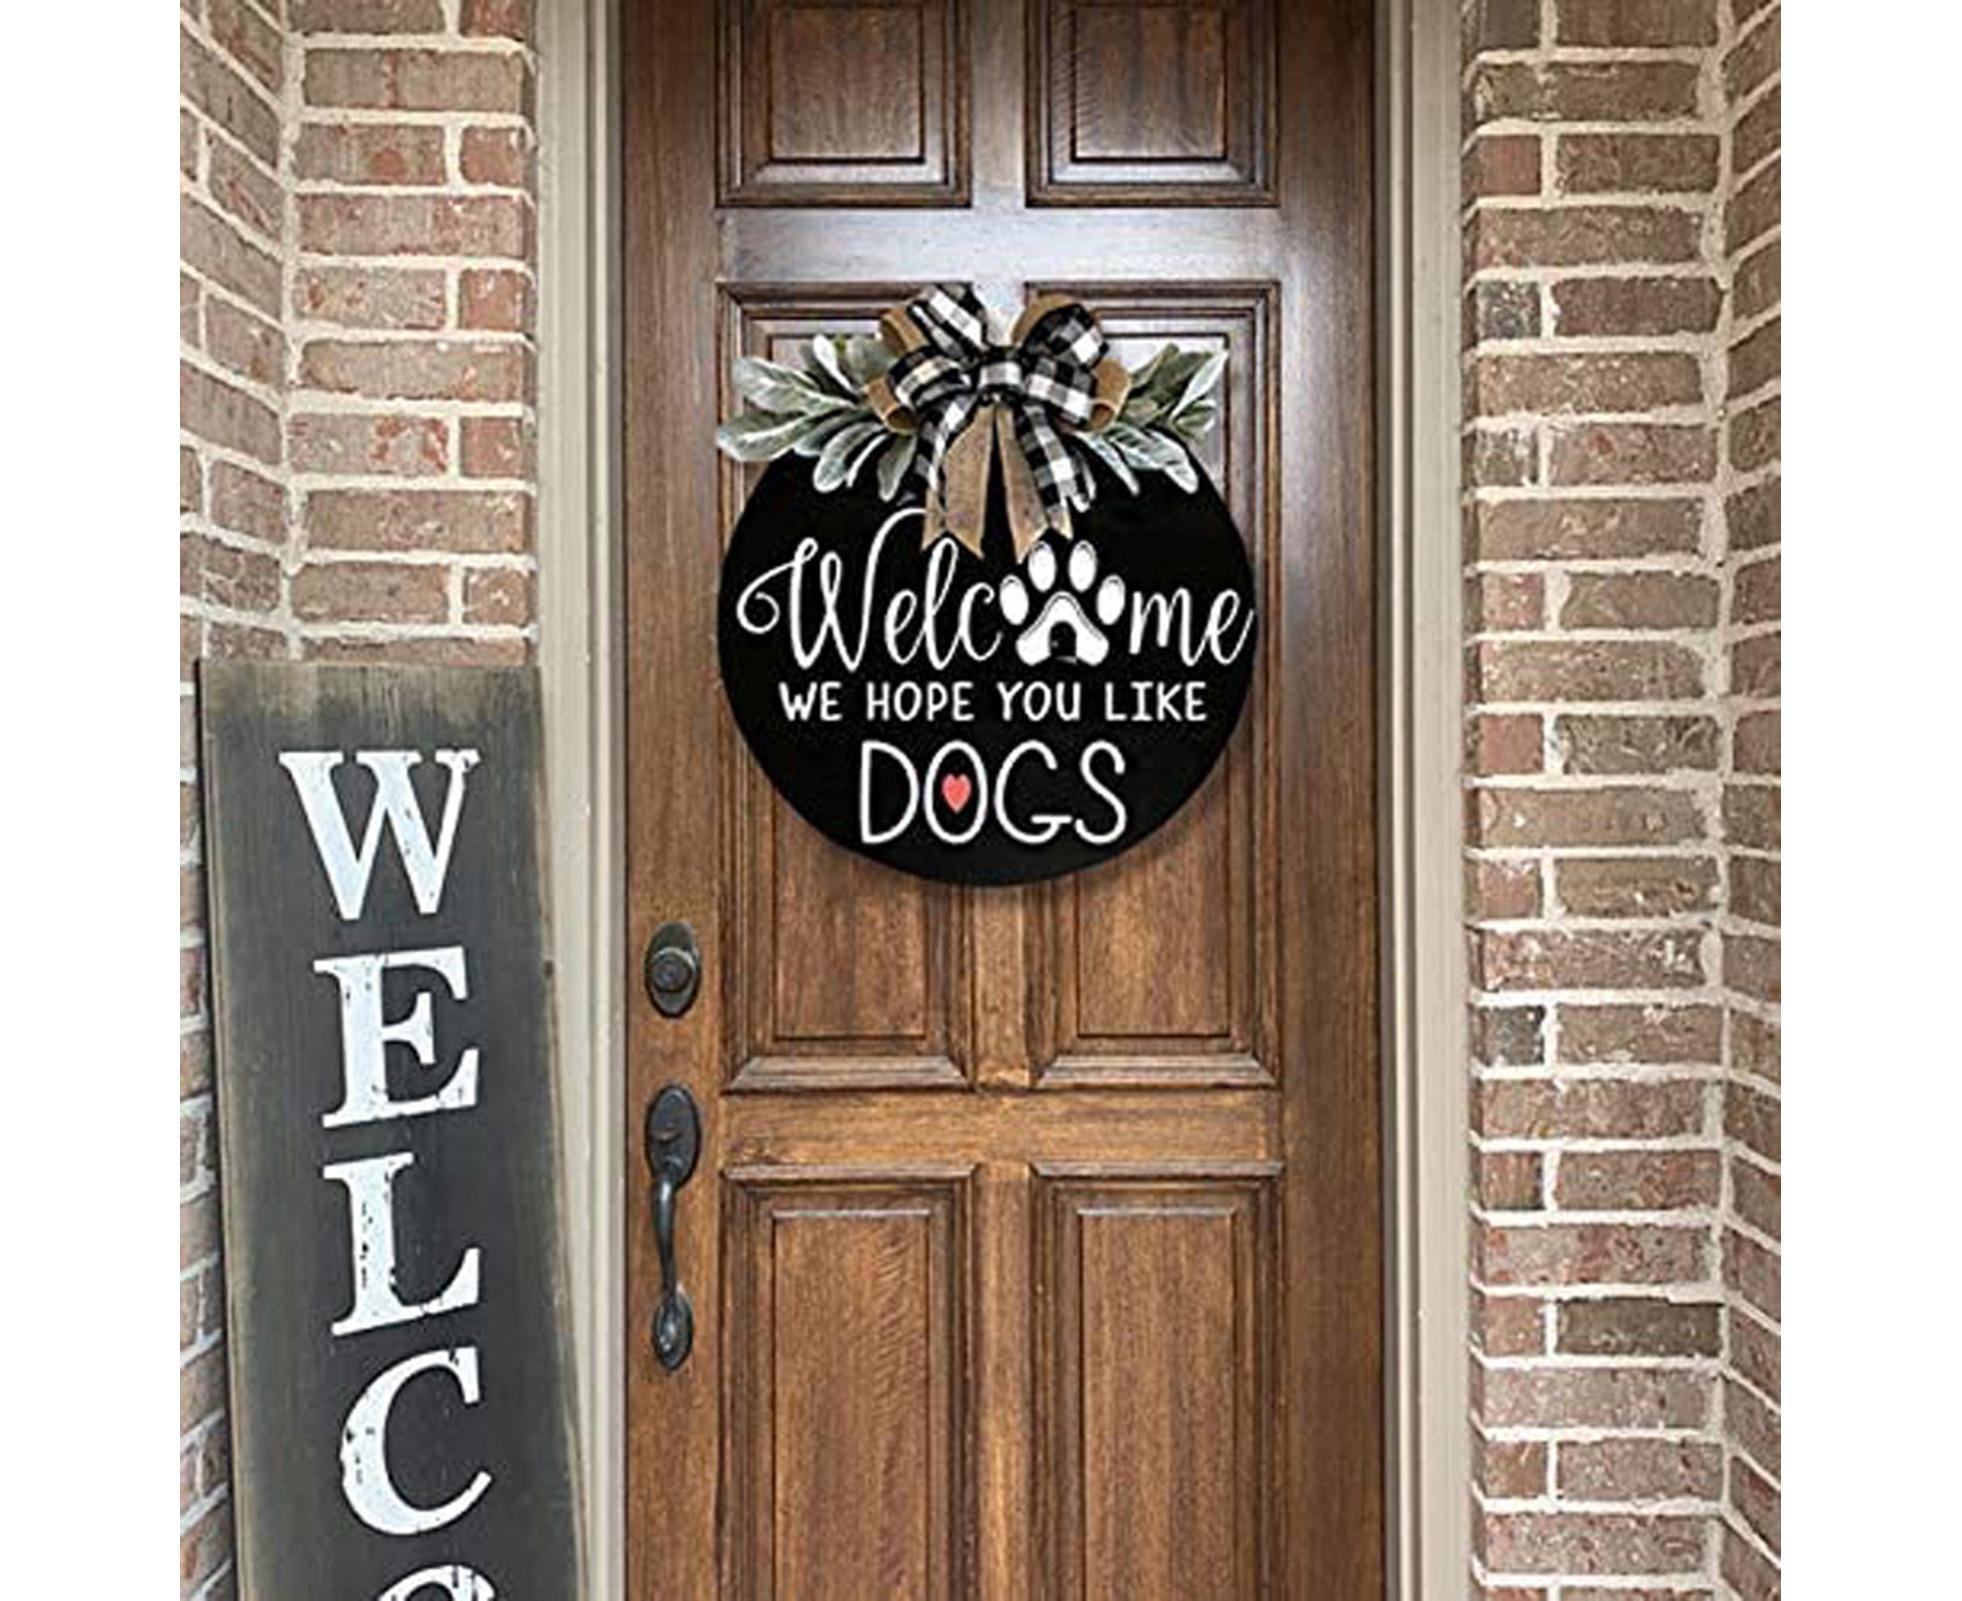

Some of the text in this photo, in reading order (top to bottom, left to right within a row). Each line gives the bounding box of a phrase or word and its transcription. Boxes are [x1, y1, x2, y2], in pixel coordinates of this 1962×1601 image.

[737, 508, 1254, 671] Welcme
[779, 681, 1207, 722] WE HOPE YOU LIKE
[860, 740, 1127, 845] DOGS
[279, 749, 497, 1601] WELC
